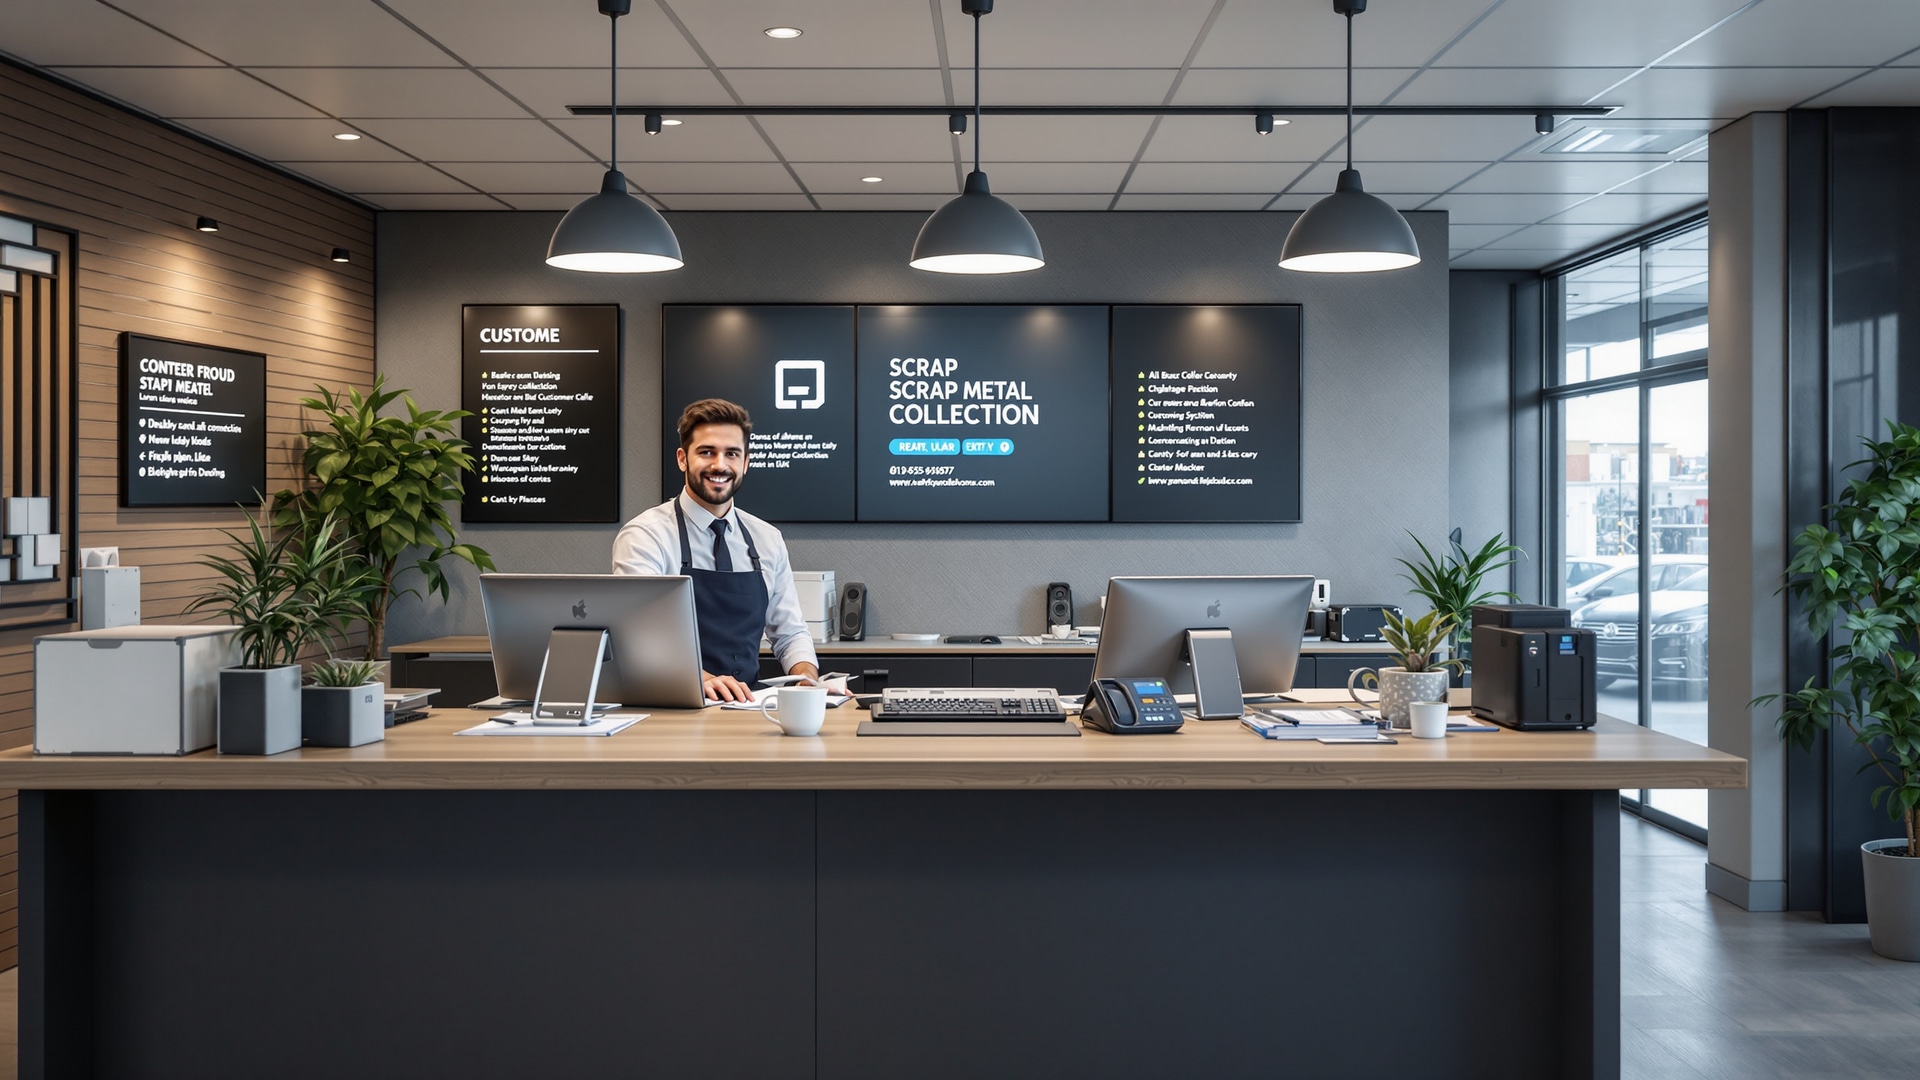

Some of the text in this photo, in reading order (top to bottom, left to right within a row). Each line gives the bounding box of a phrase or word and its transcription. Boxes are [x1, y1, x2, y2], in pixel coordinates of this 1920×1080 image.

[480, 328, 560, 343] CUSTOME
[140, 358, 235, 382] CONTEER FROUD
[889, 358, 958, 377] SCRAP
[889, 380, 1033, 400] SCRAP METAL
[889, 403, 1039, 425] COLLECTION
